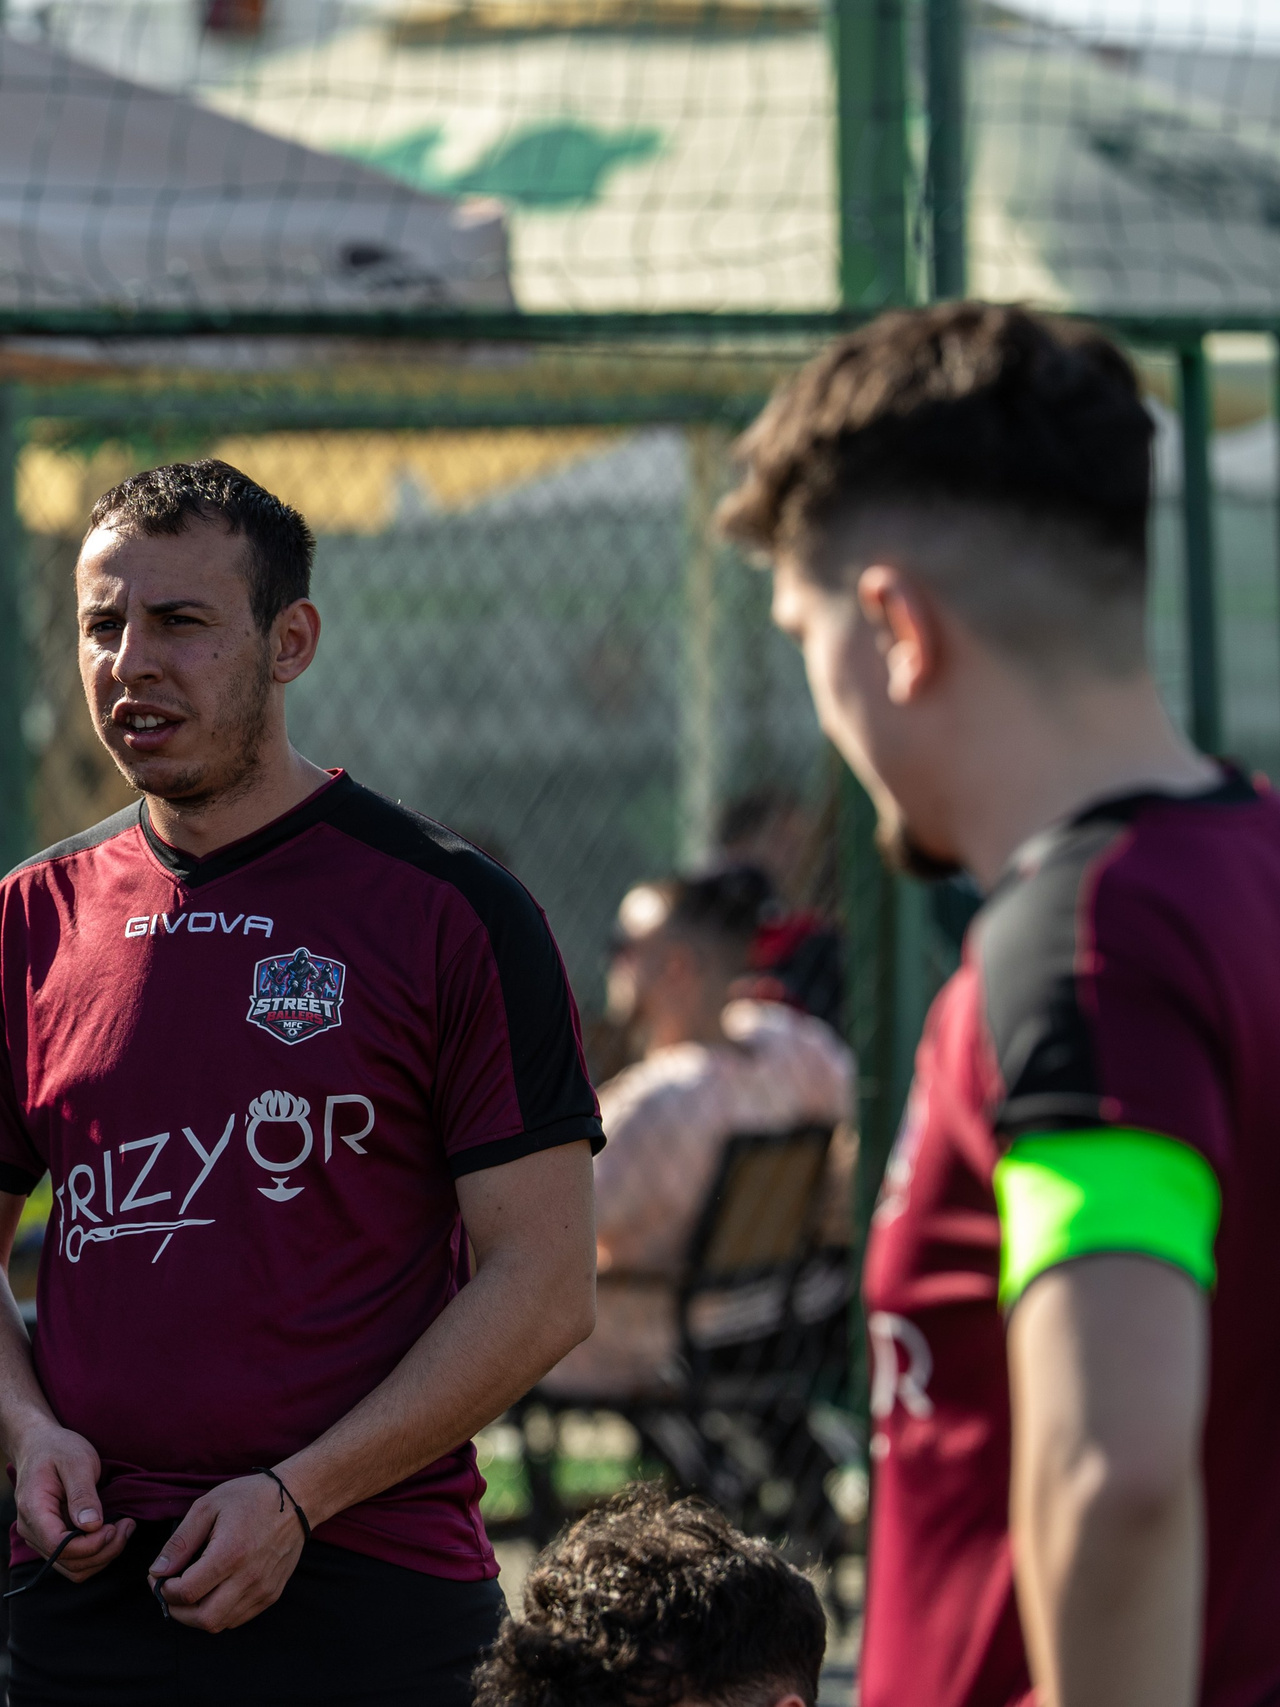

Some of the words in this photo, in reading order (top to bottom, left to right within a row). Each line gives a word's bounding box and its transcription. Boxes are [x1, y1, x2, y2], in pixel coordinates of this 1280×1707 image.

[124, 912, 274, 939] GIVOVA
[253, 997, 335, 1018] STREET
[266, 1010, 324, 1025] BALLERS
[283, 1021, 303, 1029] MFC
